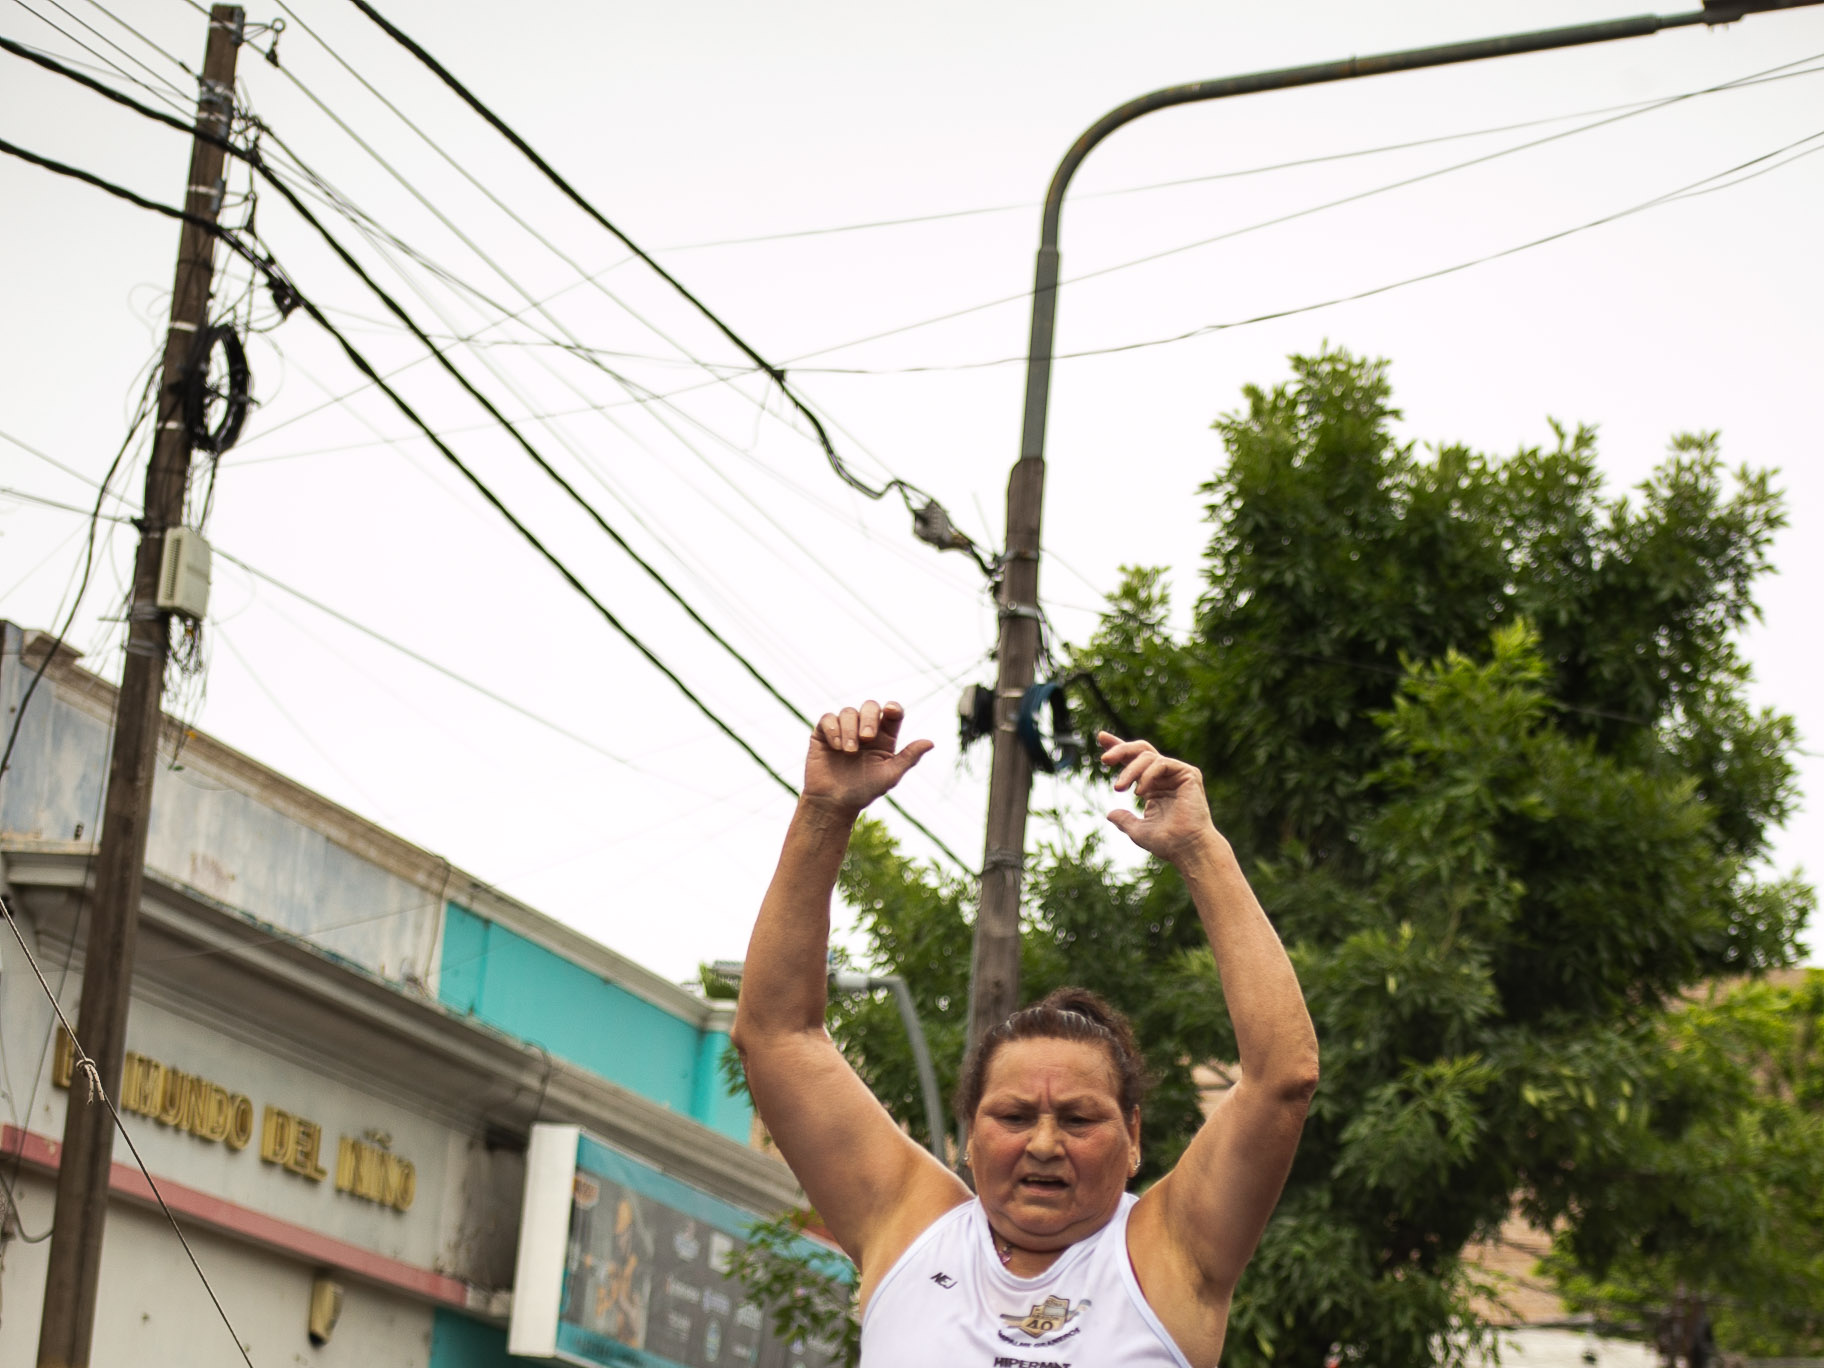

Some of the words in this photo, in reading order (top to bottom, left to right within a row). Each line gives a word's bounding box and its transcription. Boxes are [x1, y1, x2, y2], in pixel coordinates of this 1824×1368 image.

[121, 1050, 254, 1150] MUNDO
[260, 1103, 327, 1183] DEL
[336, 1127, 416, 1213] NIÑO
[1026, 1320, 1053, 1331] 40
